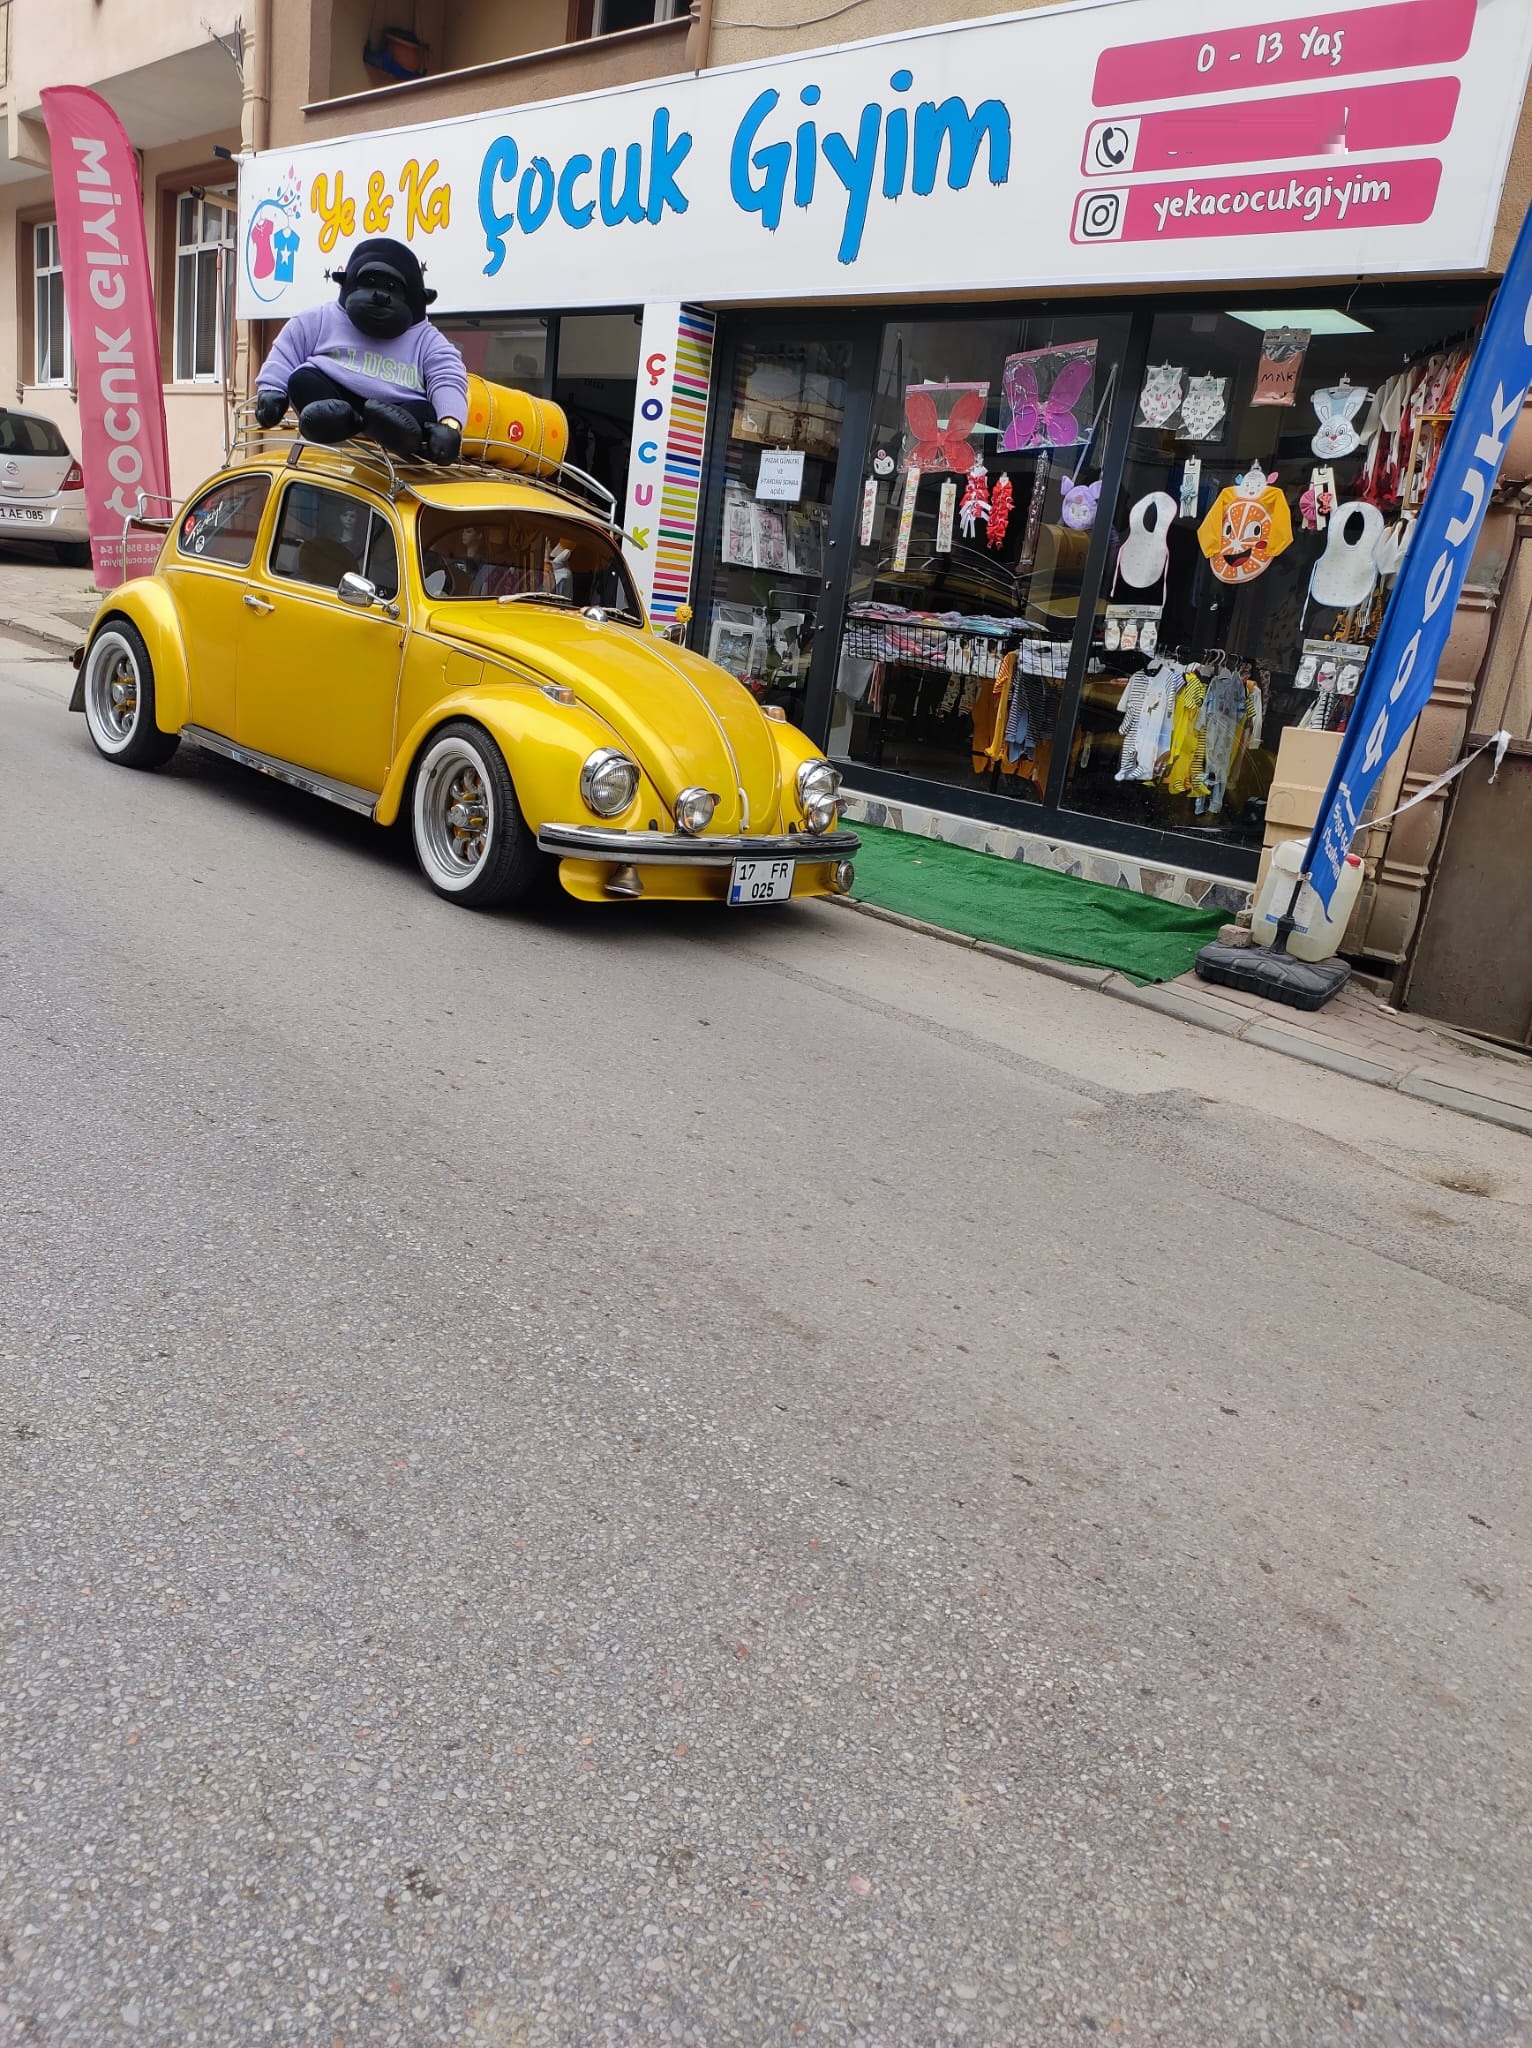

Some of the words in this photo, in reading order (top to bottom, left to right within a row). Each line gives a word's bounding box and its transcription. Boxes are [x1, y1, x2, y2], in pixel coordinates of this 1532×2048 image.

[1197, 43, 1216, 72] 0
[1256, 32, 1283, 64] 13
[1300, 26, 1345, 66] Yaş
[311, 170, 355, 253] Ye
[363, 170, 394, 233] &
[399, 159, 450, 241] Ka
[478, 107, 692, 277] Çocuk
[730, 69, 1011, 265] Giyim
[1153, 174, 1391, 232] yekacocukgiyim
[631, 353, 667, 550] ÇOCUK
[9, 509, 24, 519] AE
[26, 510, 44, 520] 085
[1361, 380, 1526, 774] ÇOCUK
[739, 864, 756, 880] 17
[771, 863, 788, 879] FR
[751, 882, 775, 898] 025
